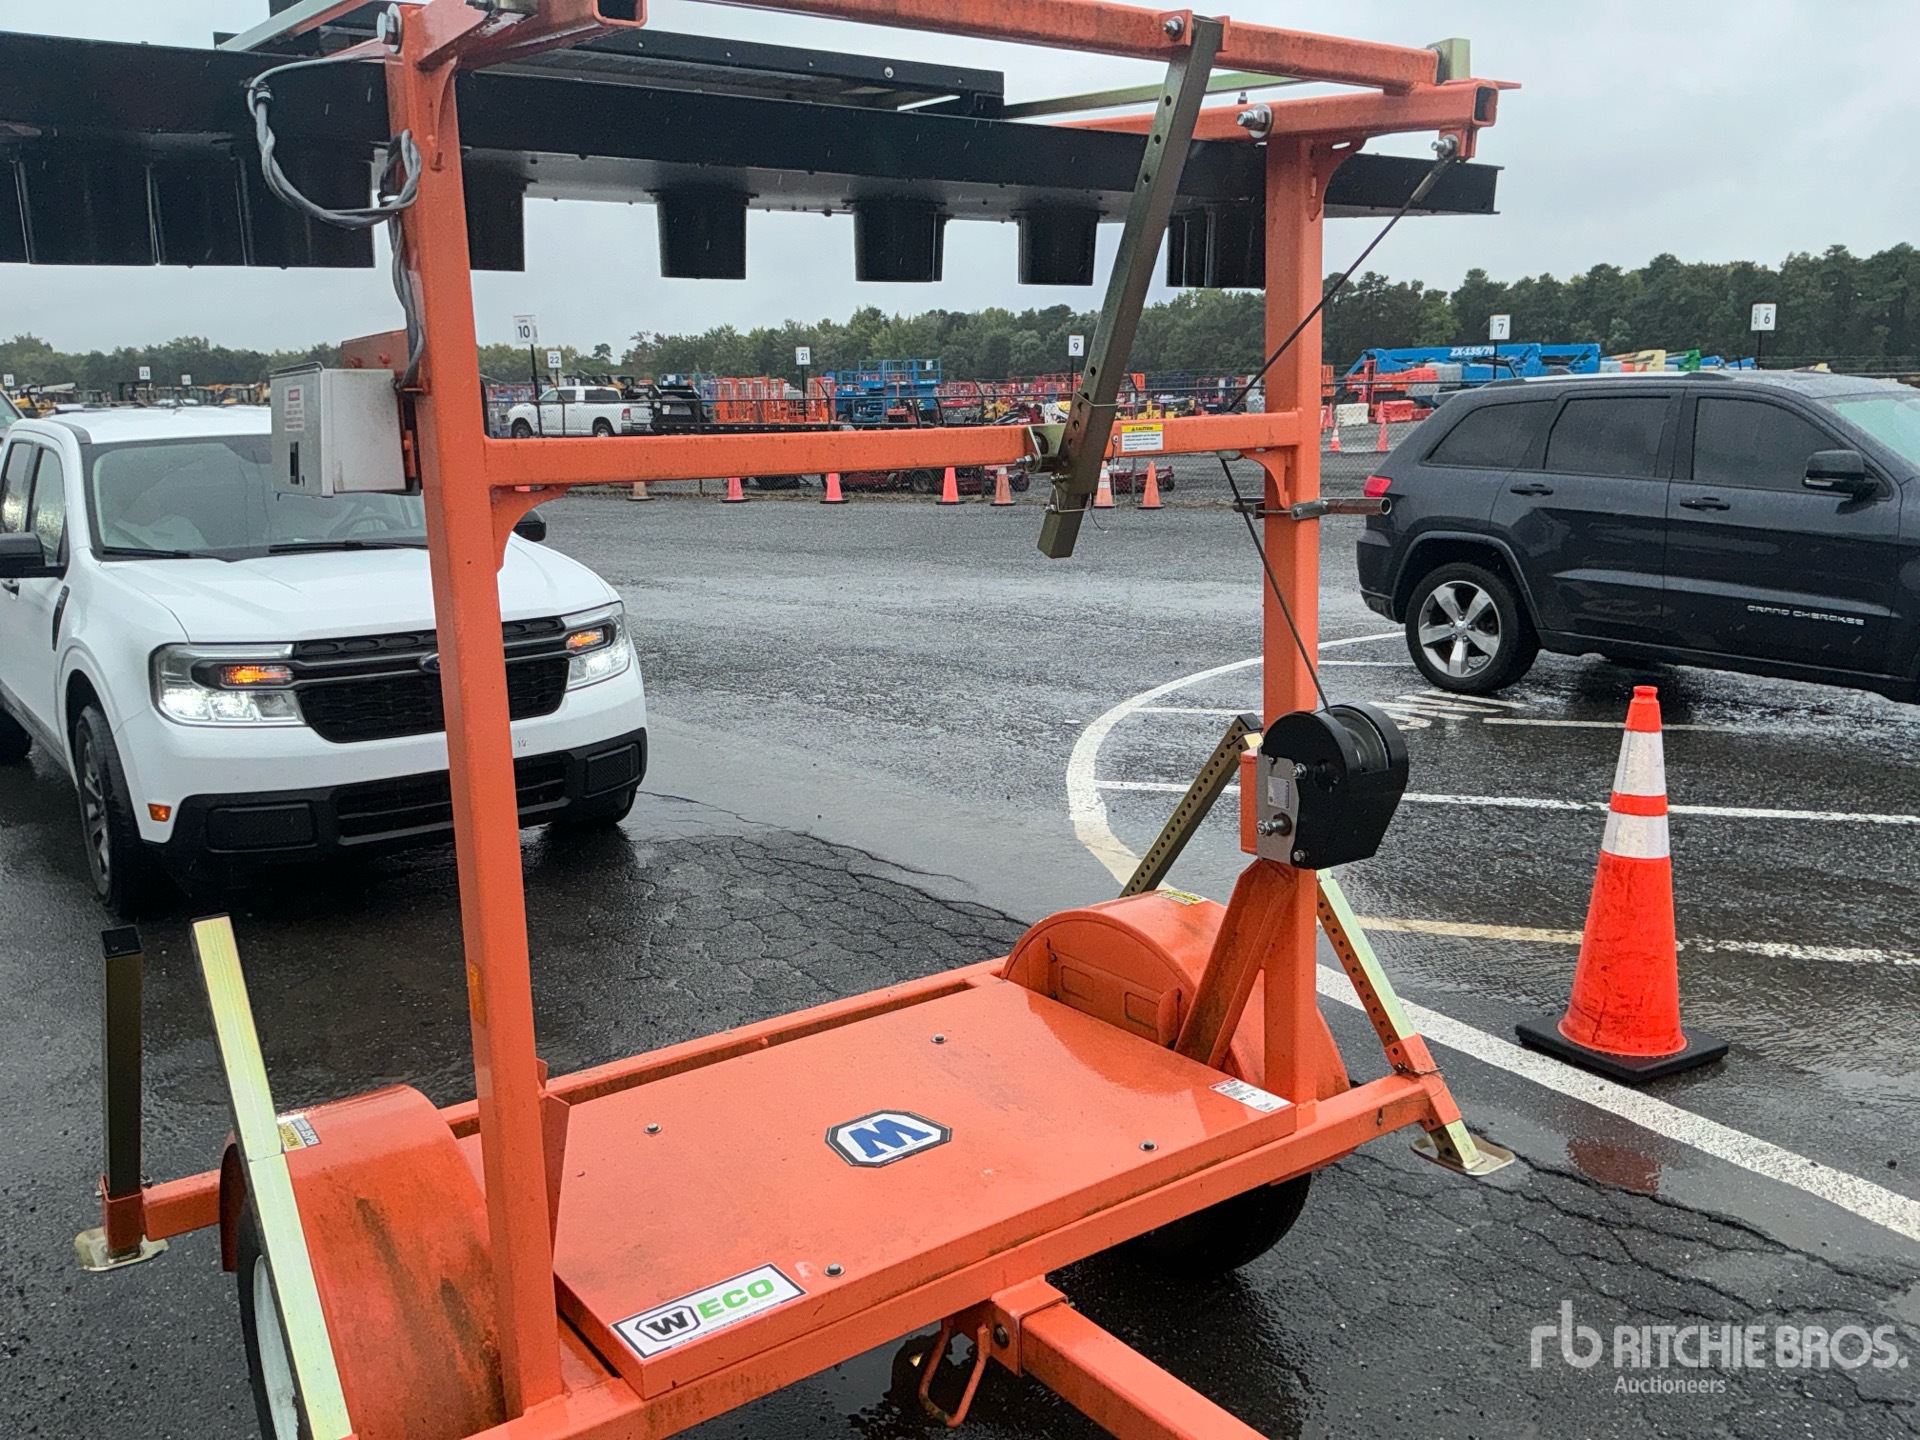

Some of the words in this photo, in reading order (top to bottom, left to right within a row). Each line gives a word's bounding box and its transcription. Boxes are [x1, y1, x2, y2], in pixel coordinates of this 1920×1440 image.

[1764, 312, 1771, 325] 6
[517, 325, 531, 339] 10
[1498, 323, 1505, 334] 7
[1073, 342, 1079, 351] 9
[549, 356, 560, 364] 22
[800, 352, 808, 361] 21
[1747, 605, 1790, 616] GRAND
[1793, 610, 1865, 626] CHEROKEE
